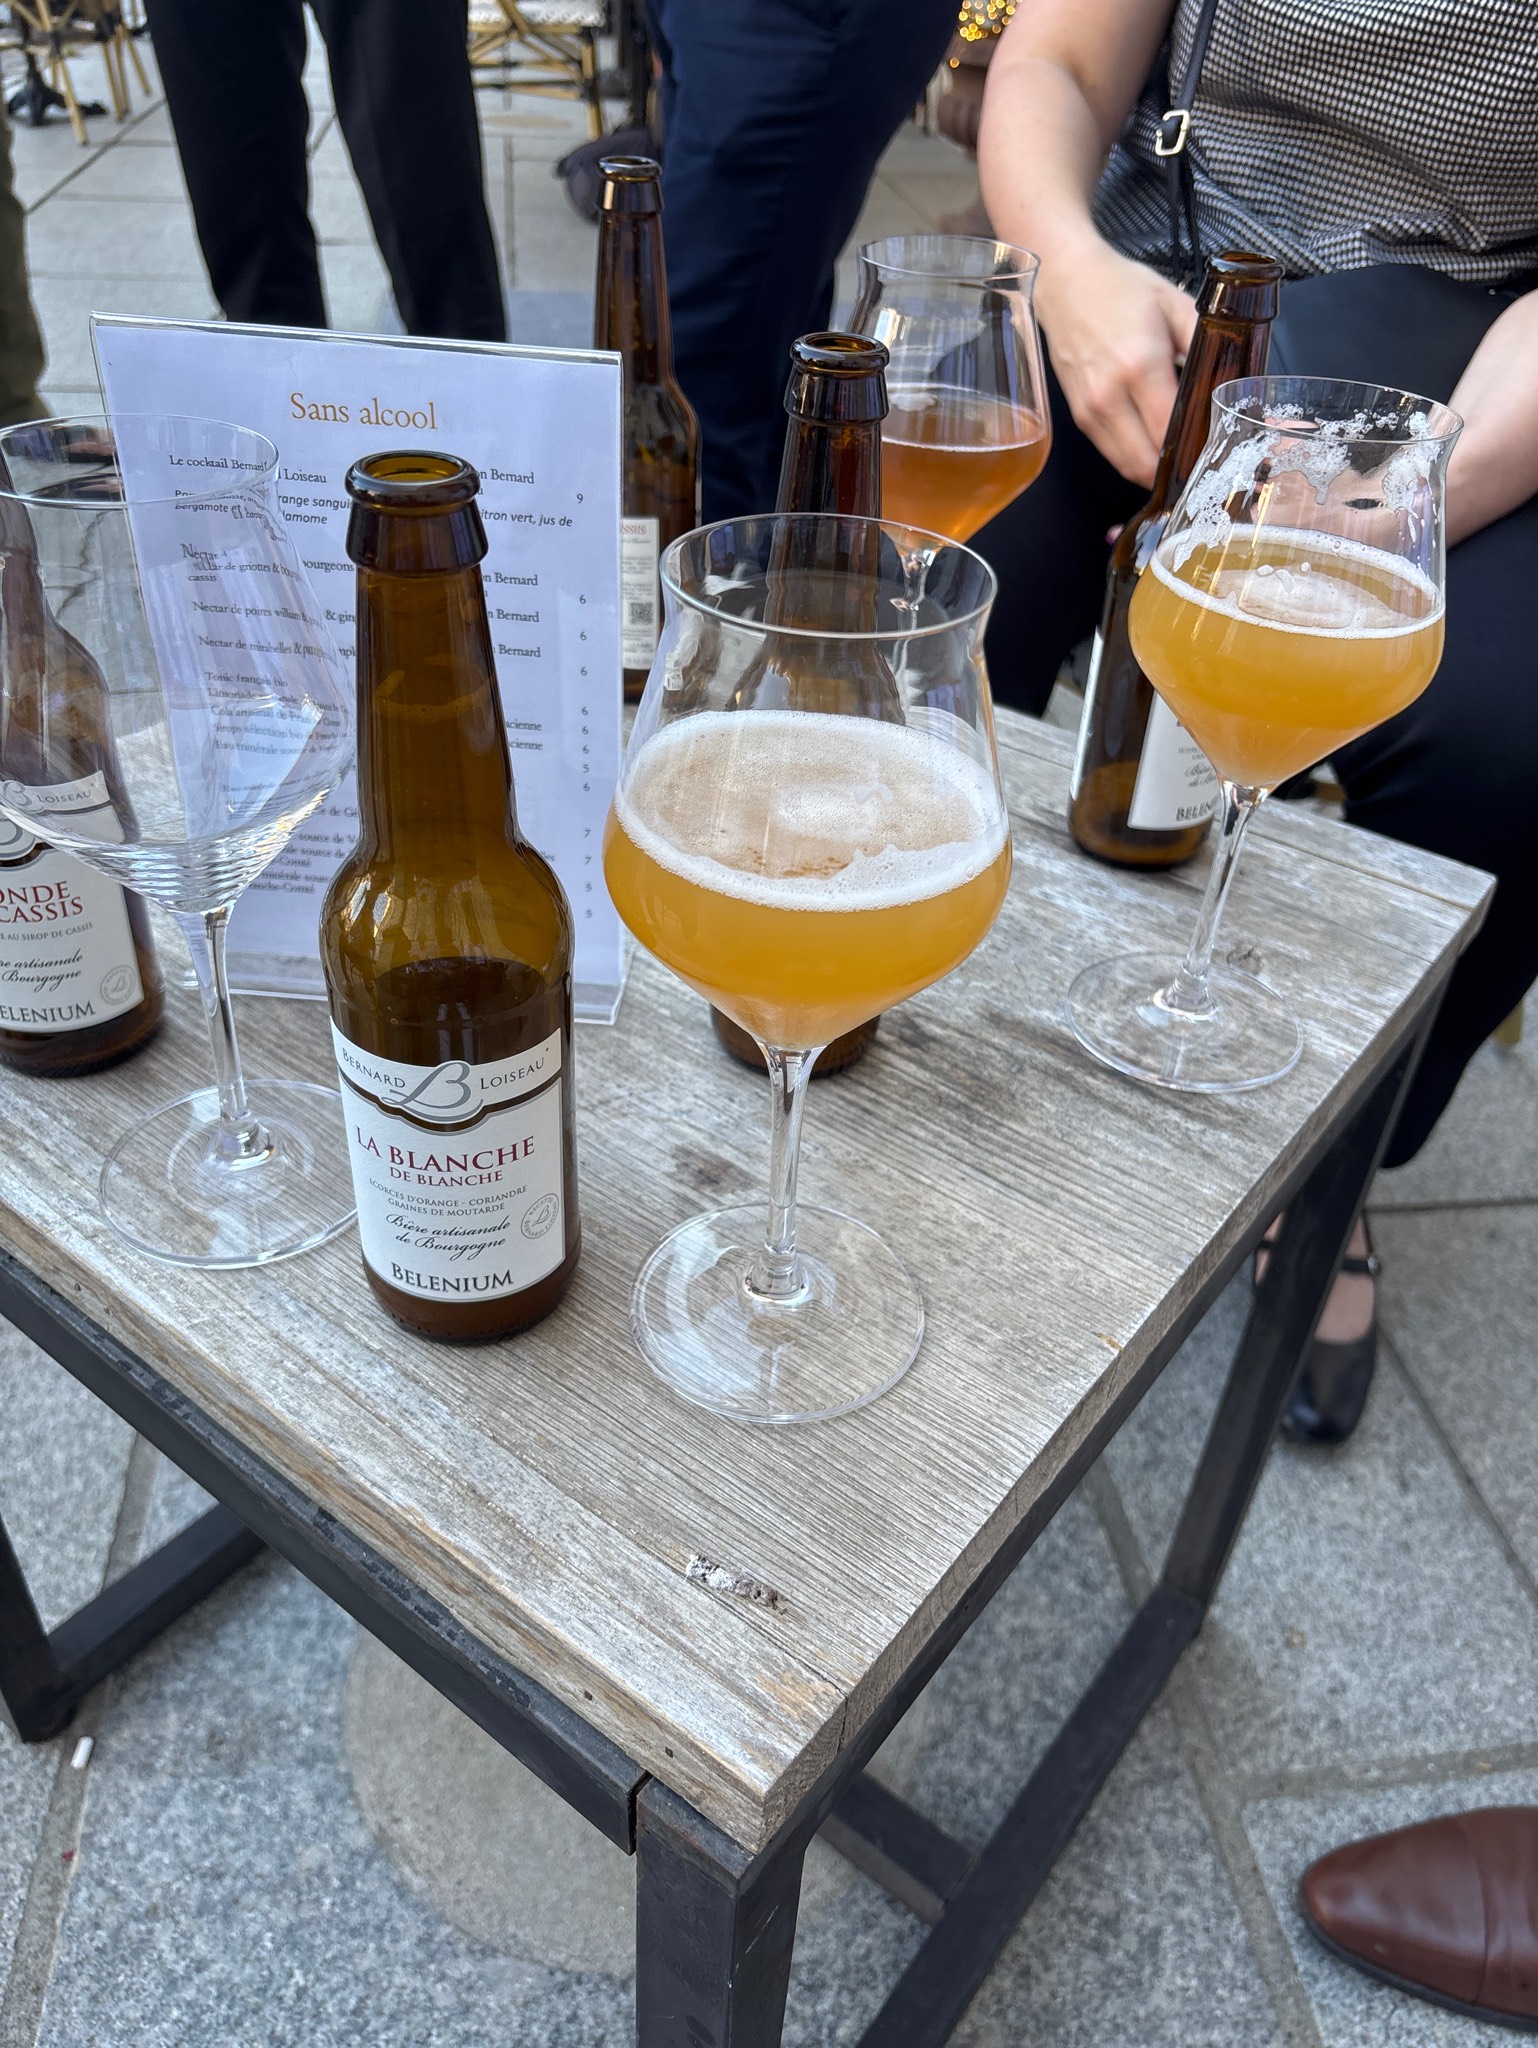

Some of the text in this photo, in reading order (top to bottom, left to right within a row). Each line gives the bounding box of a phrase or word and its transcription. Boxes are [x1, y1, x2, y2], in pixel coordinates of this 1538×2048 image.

[290, 392, 438, 430] Sans alcool
[169, 455, 184, 466] Le
[187, 456, 229, 469] cocktail
[284, 468, 327, 484] Loiseau
[490, 468, 535, 484] Bernard
[278, 494, 351, 510] range sangui
[576, 493, 585, 504] 9
[480, 509, 573, 527] itron vert, jus de
[188, 574, 217, 583] cassis
[494, 572, 539, 586] Bernard
[579, 594, 587, 605] 6
[192, 601, 229, 614] Nectar
[231, 604, 243, 614] de
[245, 607, 273, 618] poires
[496, 608, 540, 622] Bernard
[198, 636, 234, 649] Nectar
[235, 638, 247, 650] de
[580, 631, 587, 641] 6
[499, 644, 541, 657] Bernard
[205, 671, 234, 683] Tonic
[581, 667, 588, 676] 6
[582, 706, 589, 716] 6
[582, 726, 589, 735] 6
[582, 745, 590, 755] 6
[583, 764, 590, 774] 5
[583, 782, 591, 792] 6
[37, 789, 92, 803] LOISEAU
[584, 829, 591, 838] 7
[584, 856, 592, 865] 7
[8, 933, 19, 941] AU
[22, 932, 48, 941] SIROP
[51, 930, 62, 939] DE
[65, 922, 93, 936] CASSIS
[14, 947, 83, 969] artisanale
[2, 968, 82, 992] Bourgogne
[0, 1000, 96, 1023] ELENIUM
[342, 1047, 406, 1088] BERNARD
[480, 1057, 545, 1090] LOISEAU
[355, 1124, 536, 1173] LA BLANCHE
[389, 1166, 503, 1187] DE BLANCHE
[369, 1177, 405, 1200] ECORCES
[407, 1194, 459, 1208] D'ORANGE
[468, 1184, 528, 1207] CORIANDRE
[387, 1197, 505, 1218] GRAINES DE MOUTARDE
[386, 1213, 512, 1237] Bière artisanale
[395, 1231, 506, 1262] de Bourgogne
[390, 1260, 515, 1293] BELENIUM
